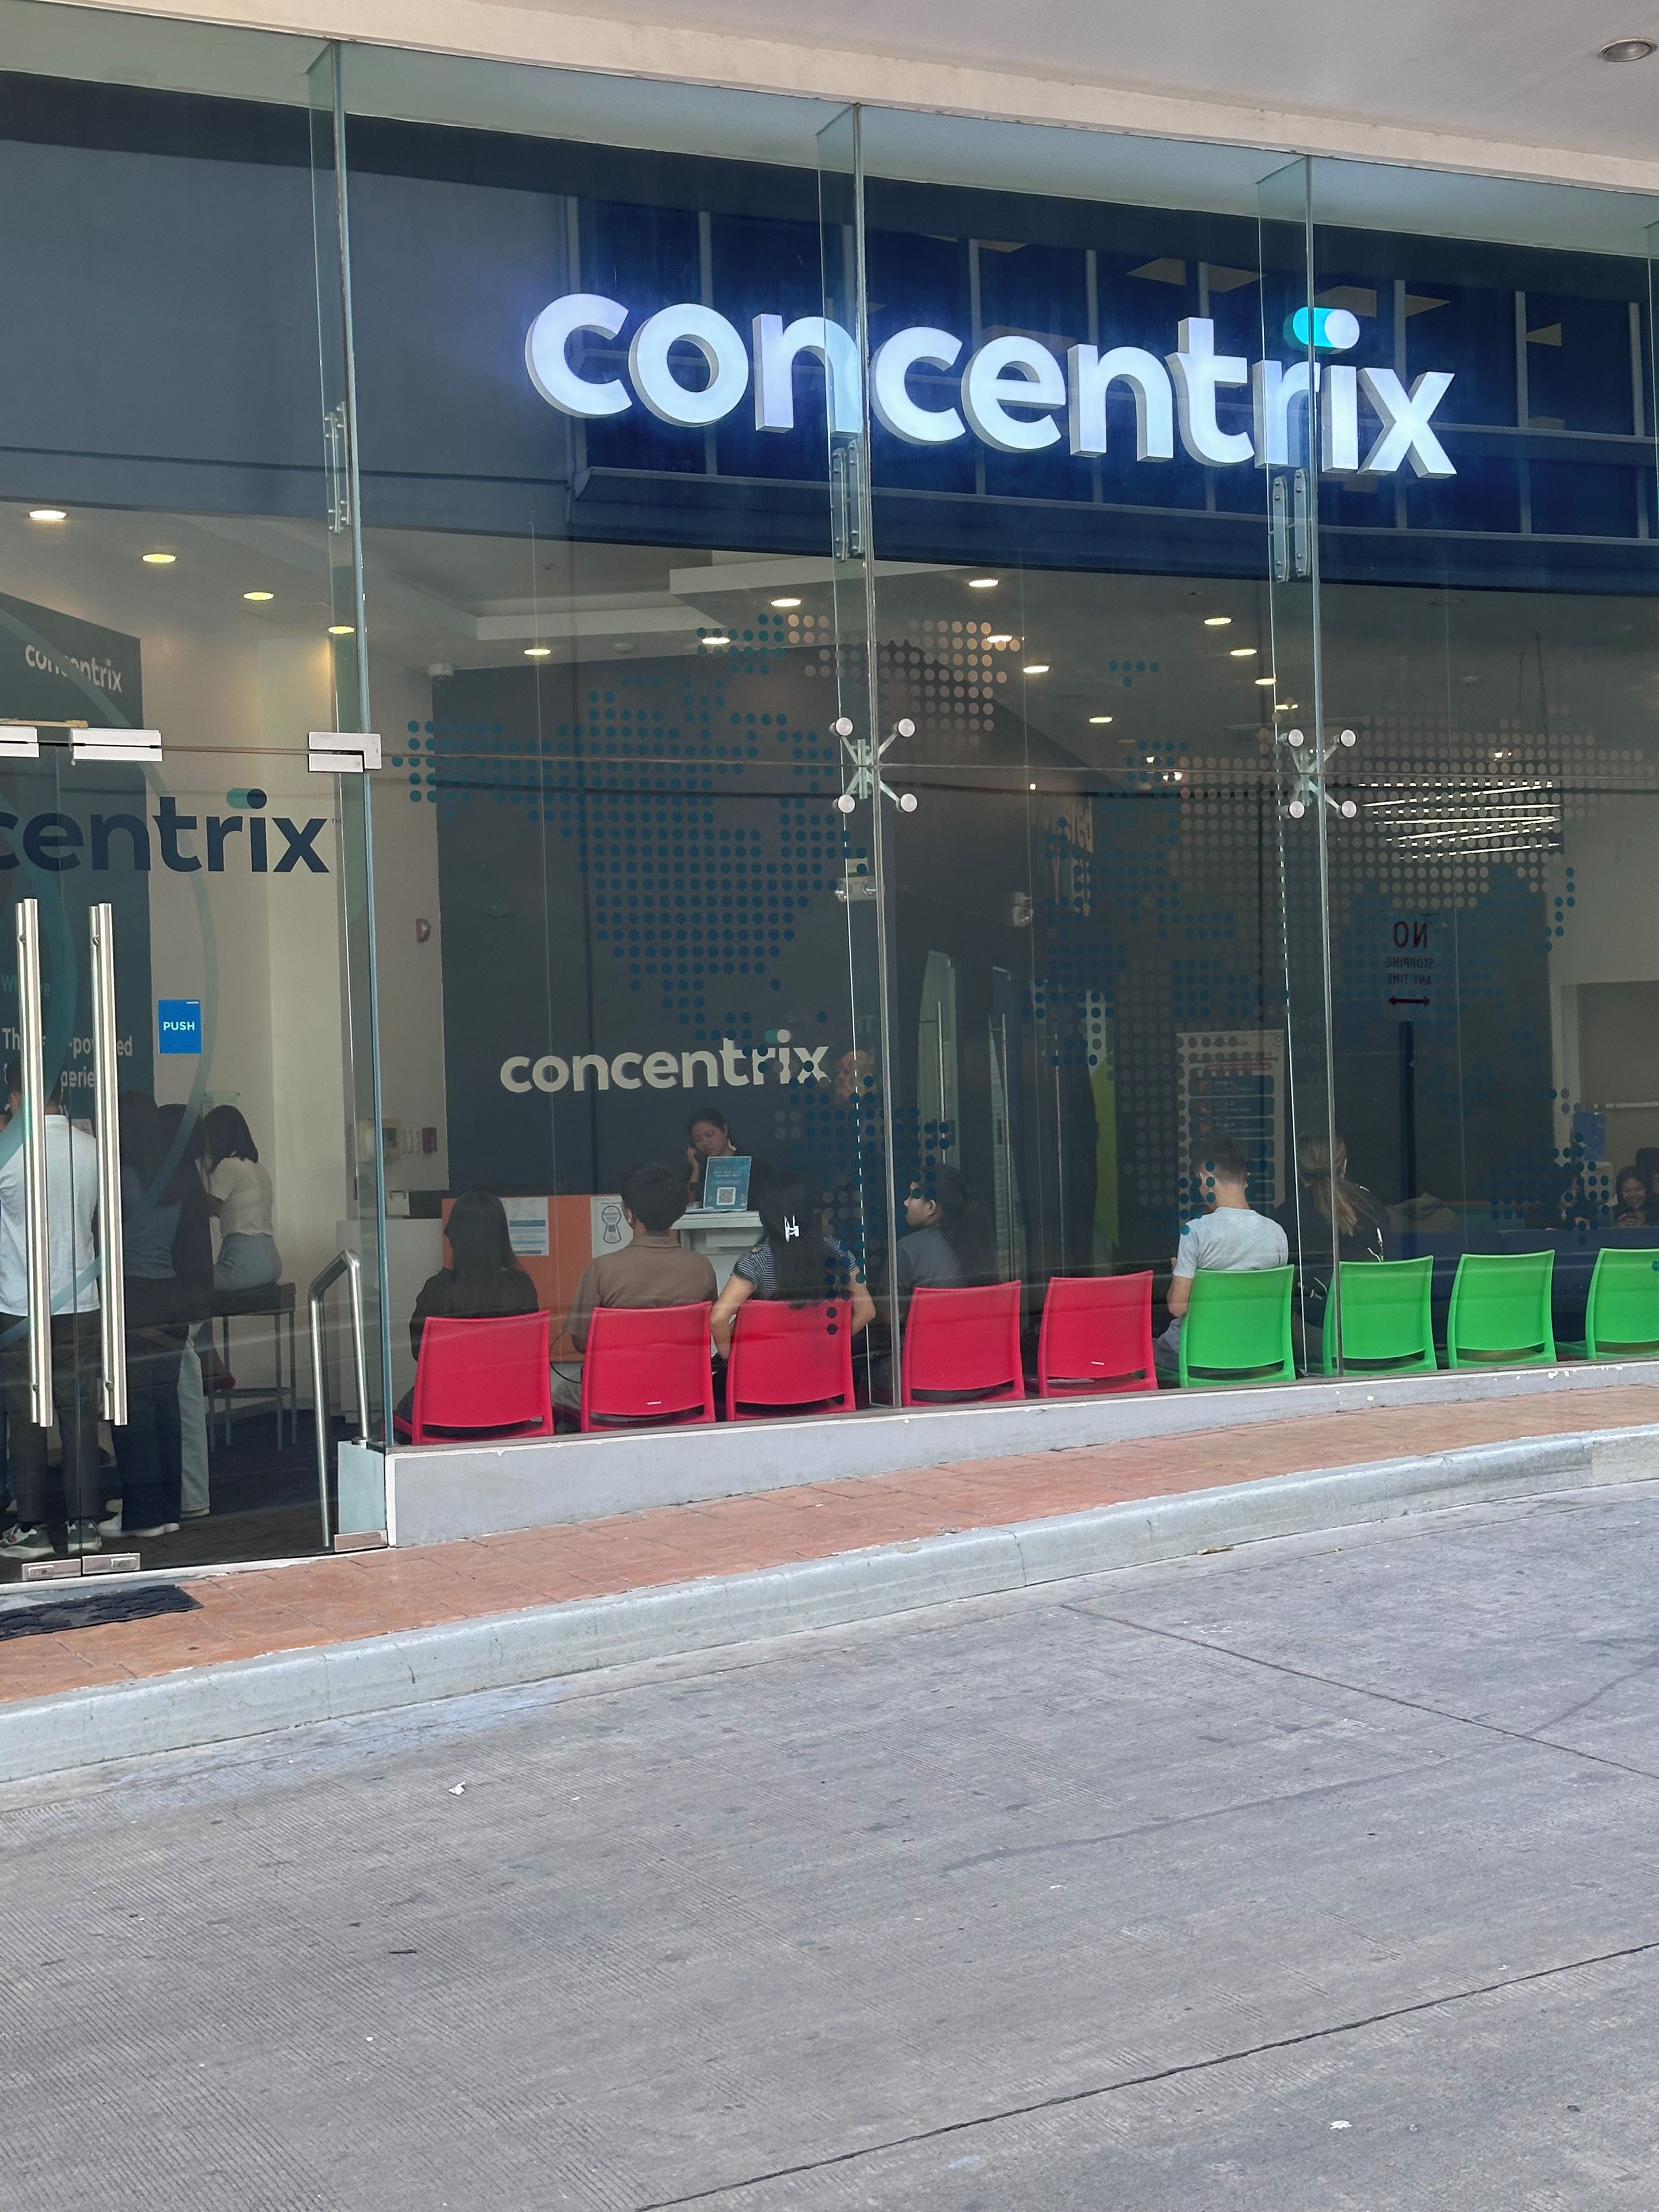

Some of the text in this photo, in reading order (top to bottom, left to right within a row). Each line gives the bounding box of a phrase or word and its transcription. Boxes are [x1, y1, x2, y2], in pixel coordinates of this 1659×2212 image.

[525, 293, 1457, 479] concentrix
[25, 645, 123, 693] contrix
[163, 1021, 195, 1031] PUSH
[500, 1029, 831, 1094] concentrix
